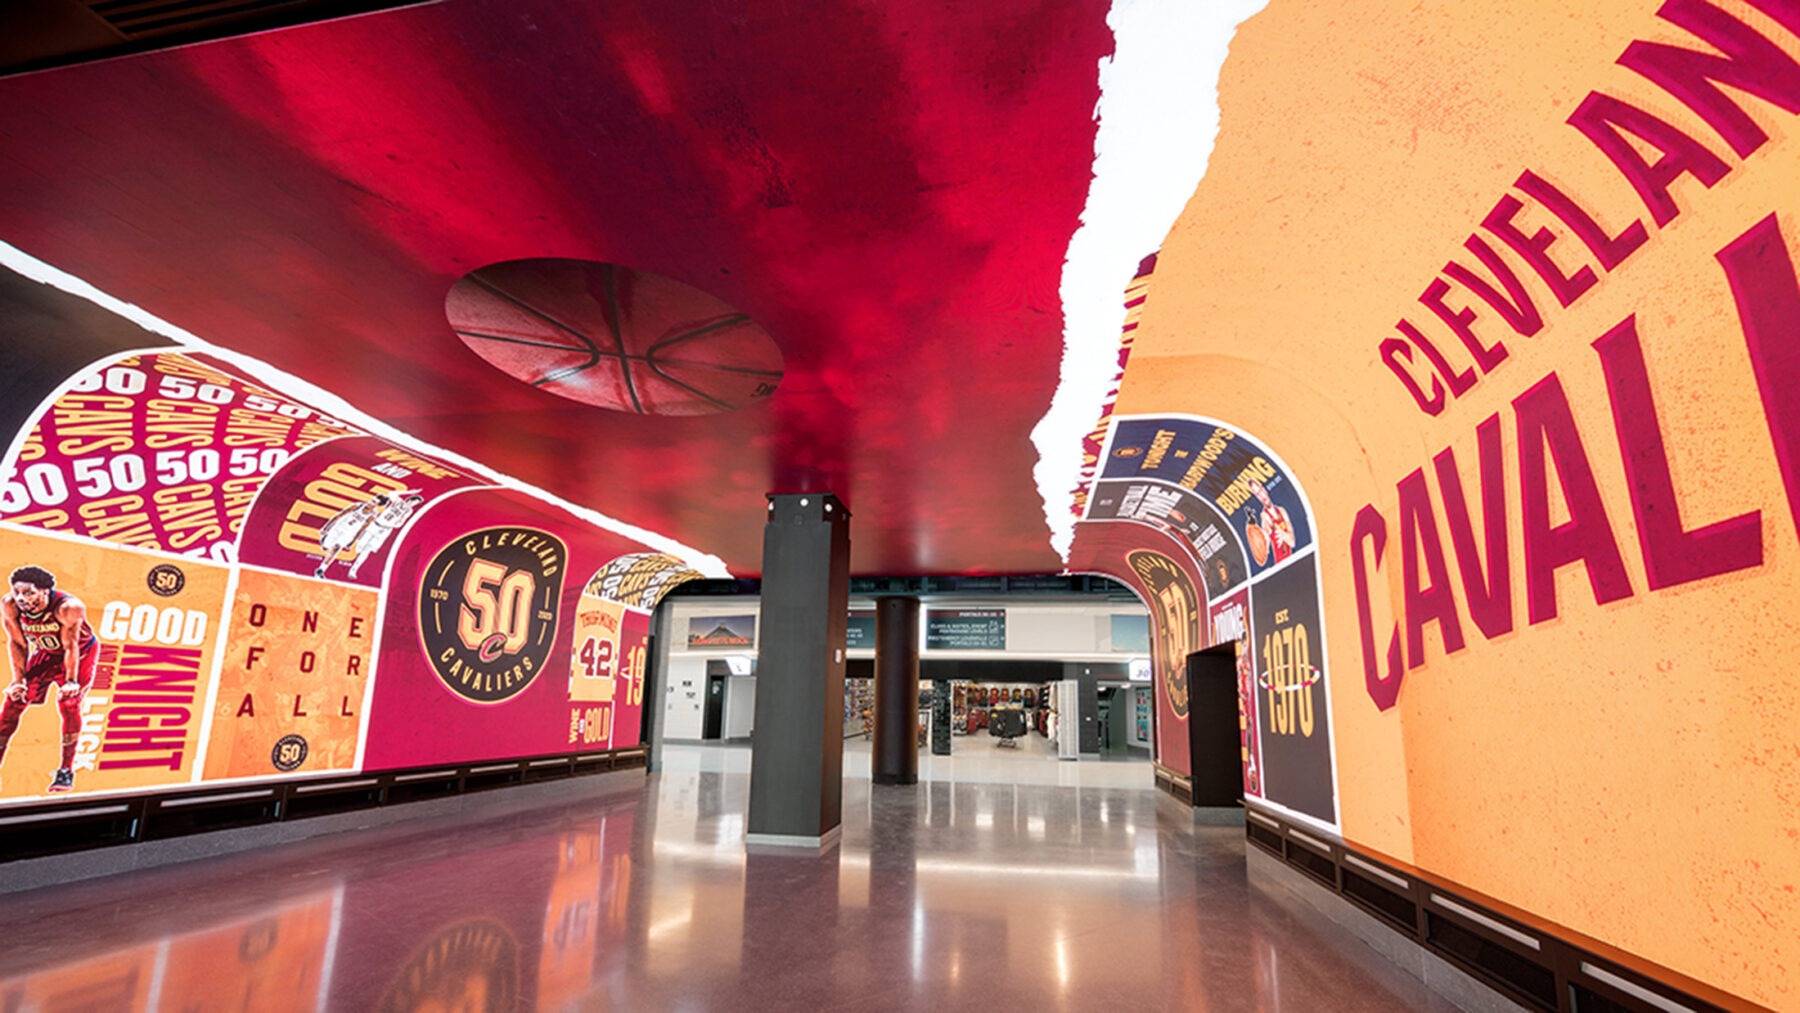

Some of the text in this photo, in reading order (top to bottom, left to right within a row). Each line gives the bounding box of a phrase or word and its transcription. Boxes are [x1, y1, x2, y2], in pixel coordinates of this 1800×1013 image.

[1379, 0, 1800, 417] CLEVELAN
[158, 375, 235, 405] 50
[243, 395, 312, 419] 50
[54, 394, 135, 455] CAVS
[145, 399, 220, 448] CAVS
[223, 408, 296, 446] CAVS
[73, 454, 146, 498] 50
[156, 448, 220, 485] 50
[1215, 456, 1276, 516] BURNING
[153, 483, 222, 548] CAVS
[465, 532, 558, 577] CLEVELAND
[156, 571, 177, 590] 50
[100, 601, 208, 646] GOOD
[250, 603, 364, 639] ONE
[457, 558, 536, 654] 50
[246, 646, 361, 676] FOR
[441, 647, 533, 692] CAVALIERS
[580, 637, 612, 678] 42
[1263, 623, 1314, 738] 1970
[99, 644, 203, 771] KNIGHT
[236, 693, 354, 718] ALL
[280, 743, 301, 762] 50
